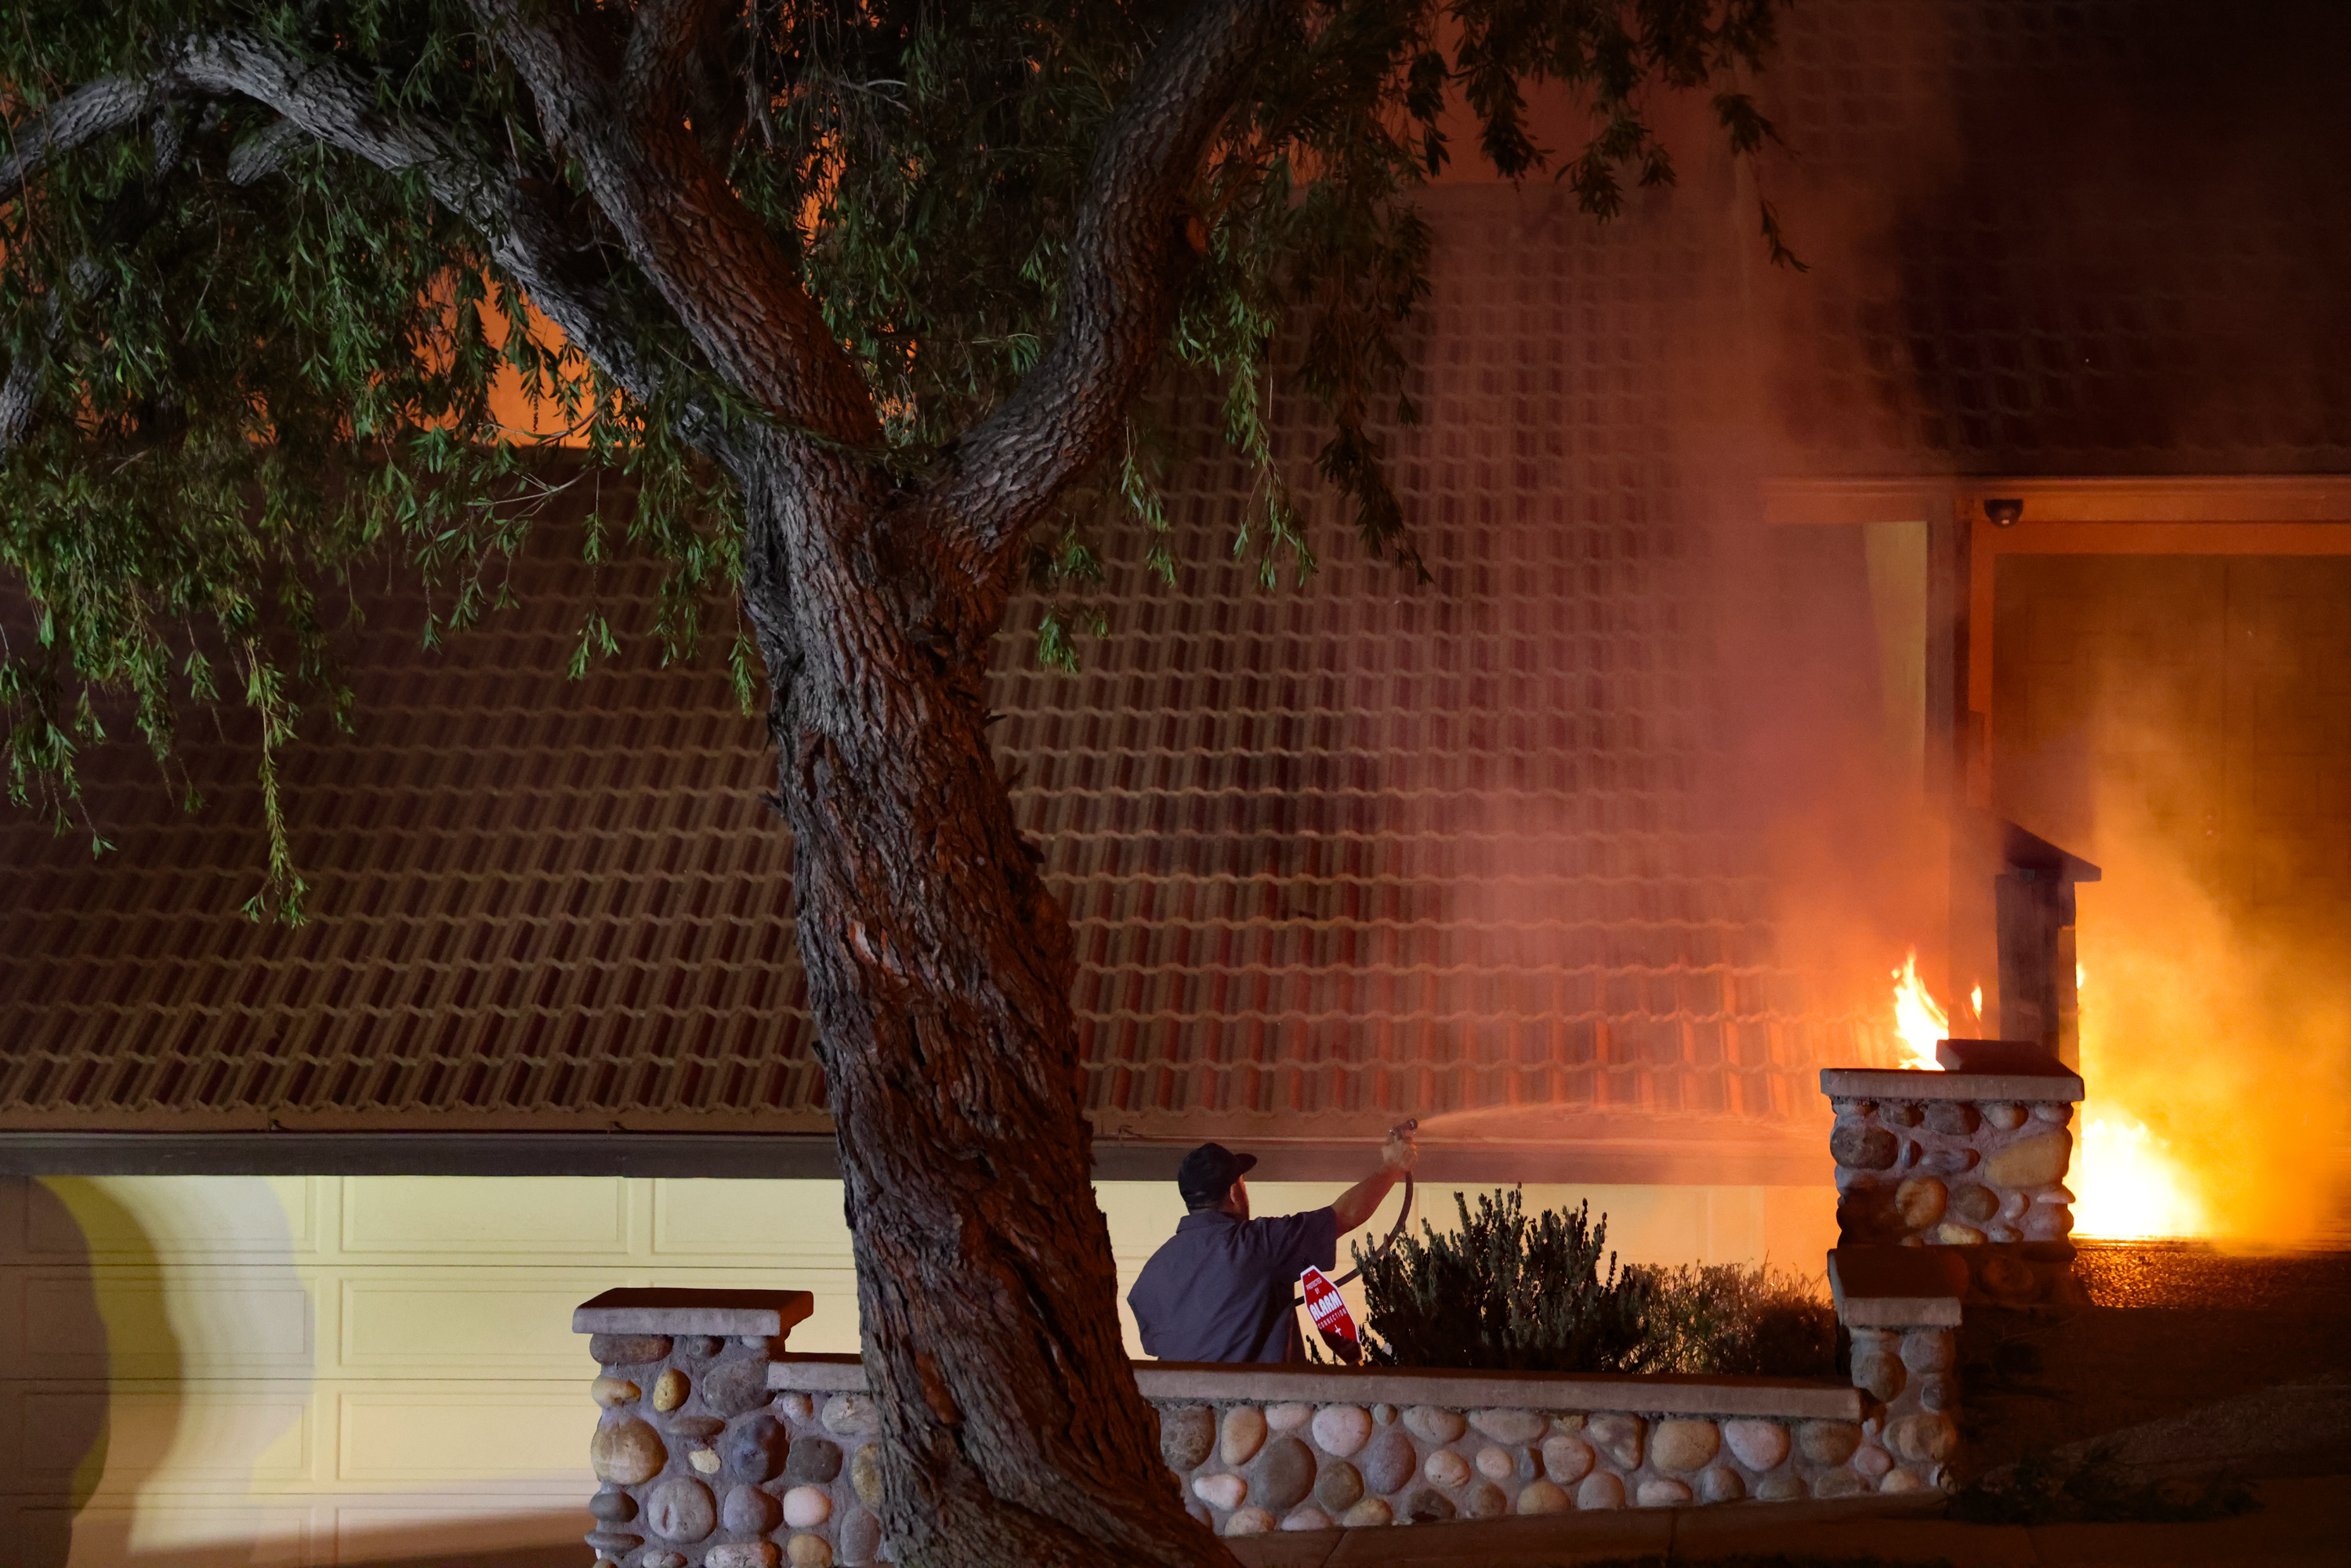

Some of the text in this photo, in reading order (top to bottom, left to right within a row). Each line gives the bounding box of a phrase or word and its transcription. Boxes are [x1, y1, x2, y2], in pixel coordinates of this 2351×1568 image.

[1306, 1277, 1323, 1291] PROTECTED
[1310, 1290, 1342, 1322] ALARM
[1317, 1307, 1347, 1330] CONNECTION
